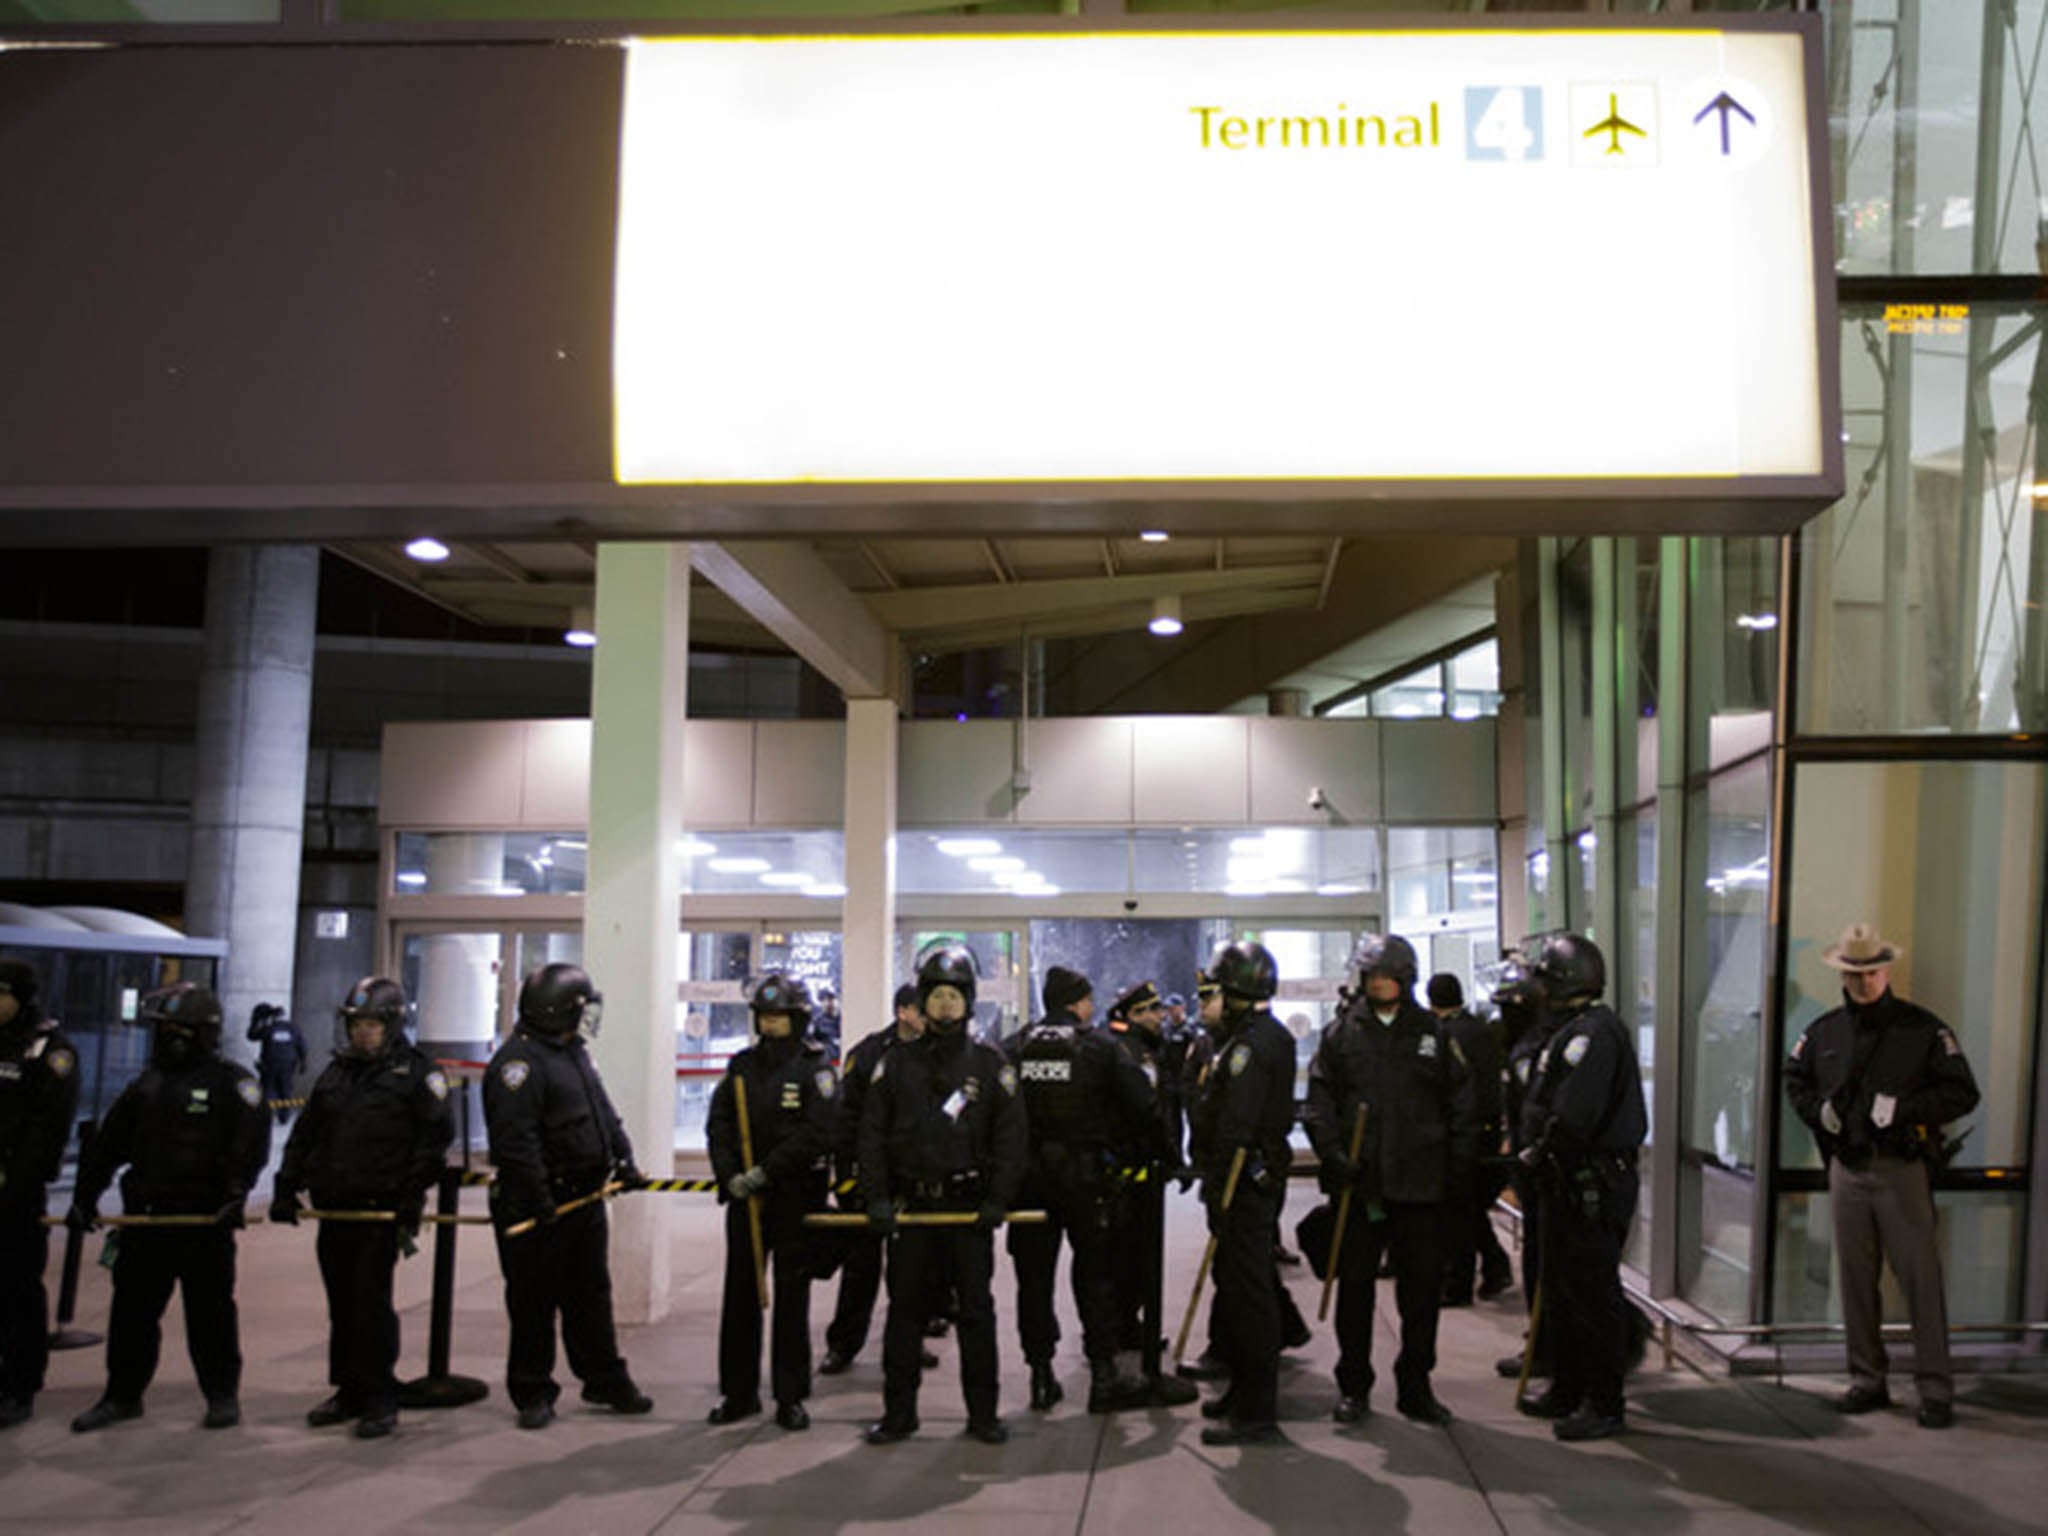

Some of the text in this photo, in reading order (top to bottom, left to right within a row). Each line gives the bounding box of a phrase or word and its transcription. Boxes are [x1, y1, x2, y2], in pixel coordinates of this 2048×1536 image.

[1190, 86, 1534, 162] Terminal 4
[1020, 1068, 1071, 1081] POLICE
